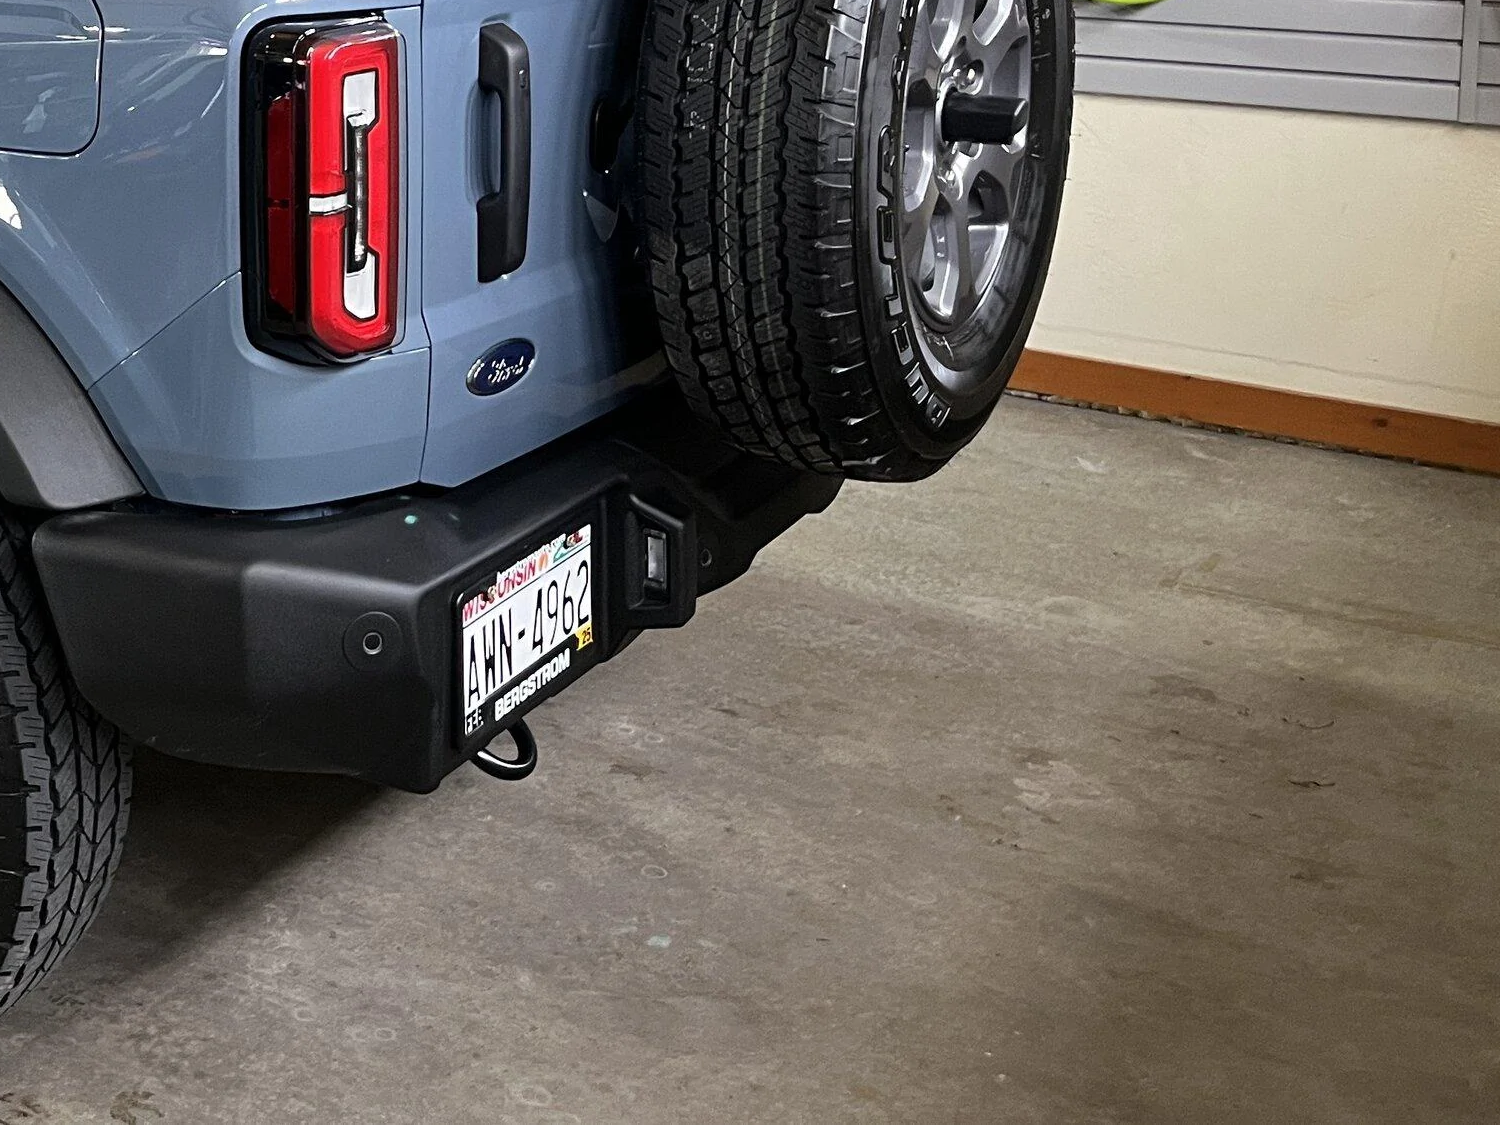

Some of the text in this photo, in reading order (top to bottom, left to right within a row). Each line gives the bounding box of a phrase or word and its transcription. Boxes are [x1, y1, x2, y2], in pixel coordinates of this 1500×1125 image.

[487, 355, 524, 383] Ford
[466, 559, 591, 709] AWN-4962
[494, 647, 571, 722] BERGSTROM
